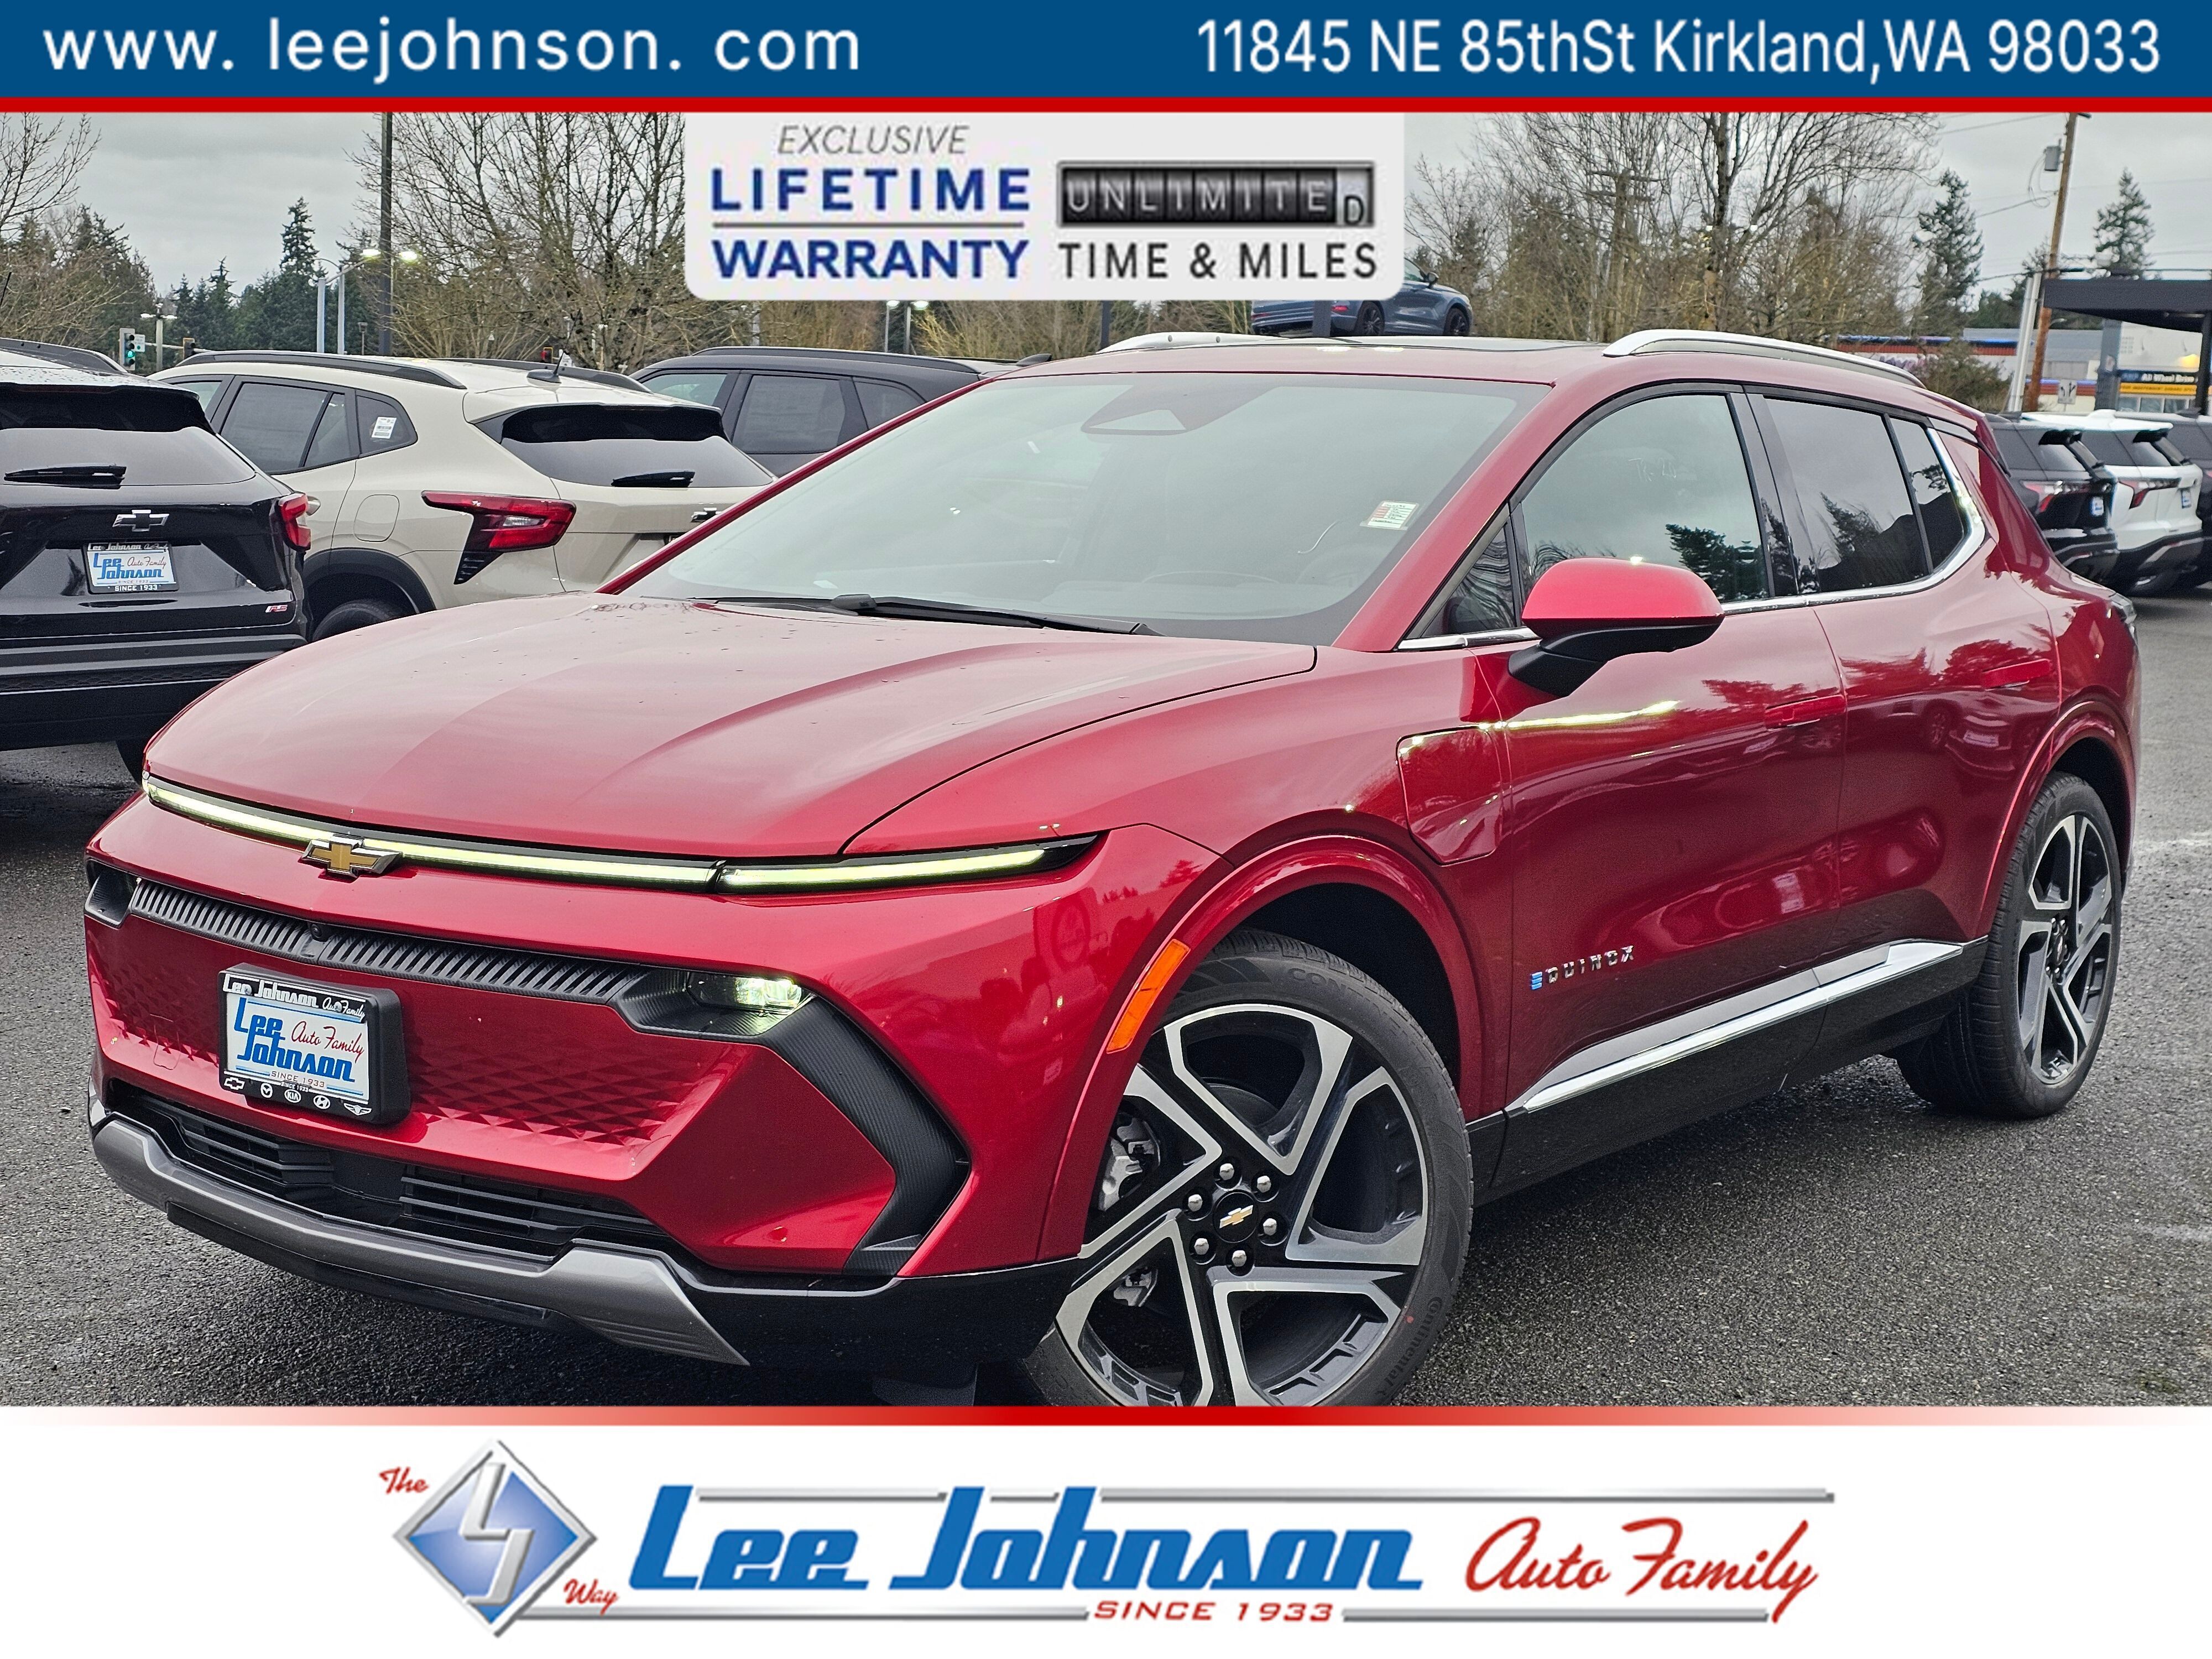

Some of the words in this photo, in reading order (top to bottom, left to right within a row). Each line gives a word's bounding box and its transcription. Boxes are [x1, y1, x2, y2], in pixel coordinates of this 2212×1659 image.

[93, 553, 124, 567] Lee
[127, 557, 144, 566] Auto
[144, 556, 166, 570] Family
[97, 559, 164, 580] Johnson
[265, 604, 288, 613] RS
[1530, 945, 1634, 990] EQUINOX
[254, 979, 319, 1009] Johnson
[322, 998, 342, 1014] Au
[340, 1000, 366, 1023] Family
[234, 997, 286, 1040] Lee
[291, 1021, 321, 1045] Auto
[323, 1026, 365, 1064] Family
[237, 1018, 356, 1083] Johnson
[271, 1071, 299, 1082] SINCE
[303, 1077, 325, 1088] 1933
[287, 1091, 299, 1101] KIA
[1383, 1297, 1443, 1386] Continental
